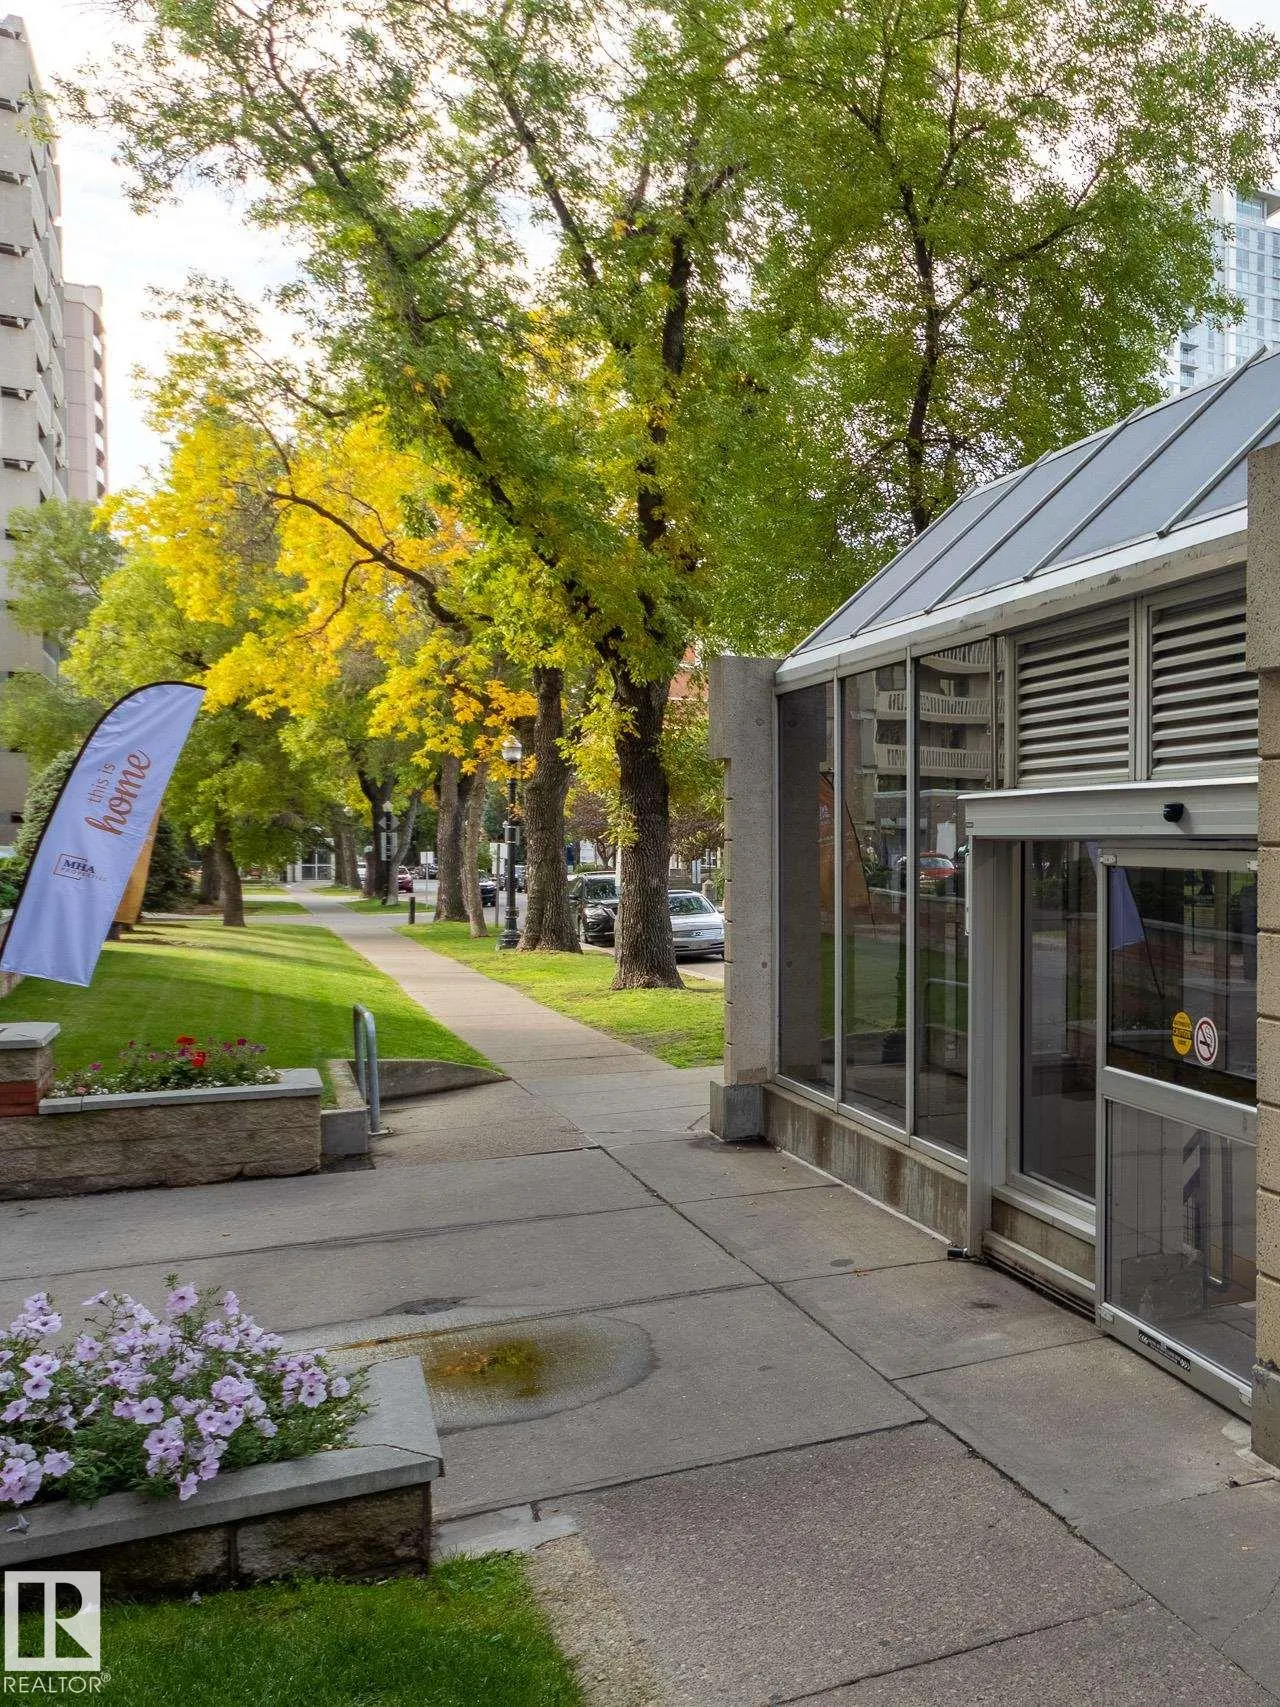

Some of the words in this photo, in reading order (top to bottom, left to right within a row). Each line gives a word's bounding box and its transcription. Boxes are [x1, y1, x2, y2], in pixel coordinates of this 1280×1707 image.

[98, 763, 116, 776] is
[84, 749, 151, 835] home
[88, 779, 109, 803] this
[63, 859, 95, 873] MHA
